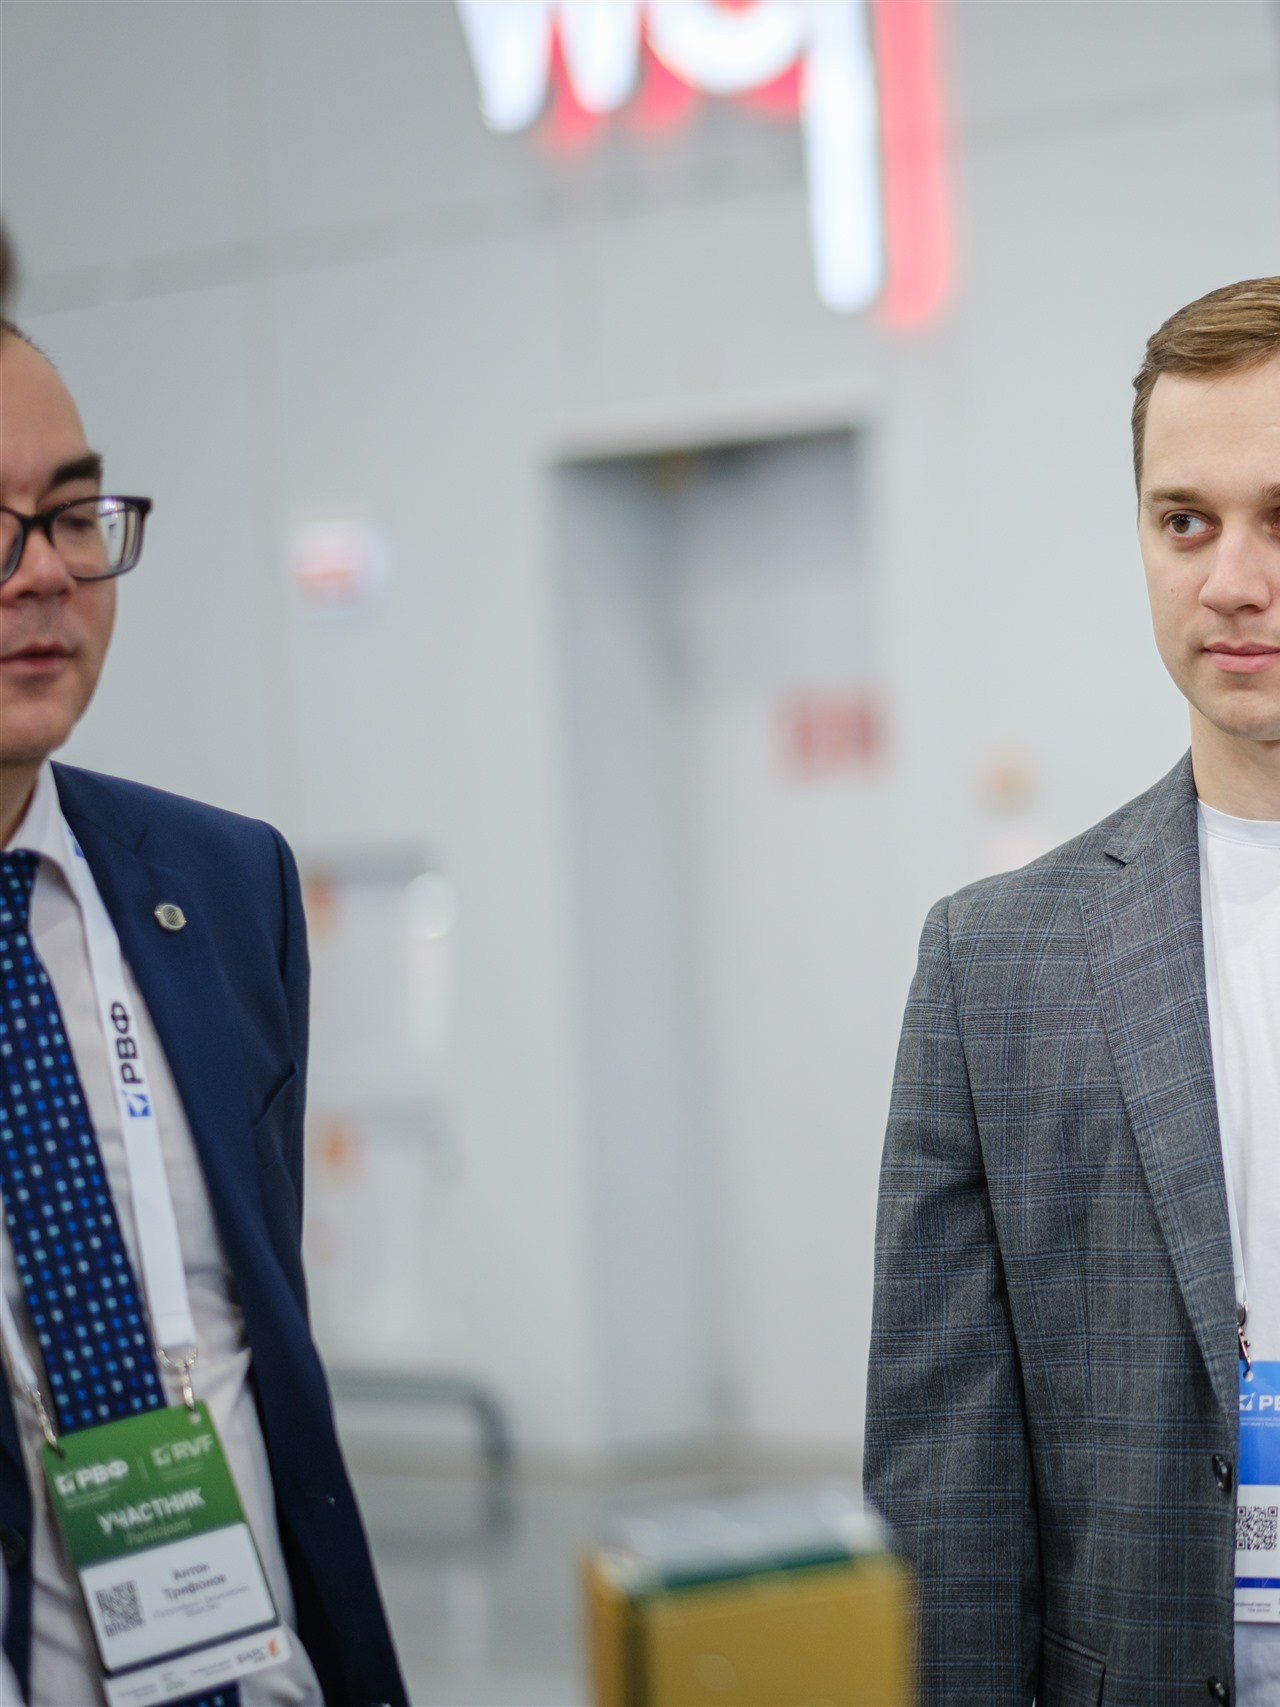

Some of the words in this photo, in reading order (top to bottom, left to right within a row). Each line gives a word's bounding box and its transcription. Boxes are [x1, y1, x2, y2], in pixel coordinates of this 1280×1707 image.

[111, 1001, 143, 1084] РВФ
[75, 1459, 130, 1490] РВФ
[97, 1487, 206, 1535] УЧАСТНИК
[172, 1563, 210, 1581] Антон
